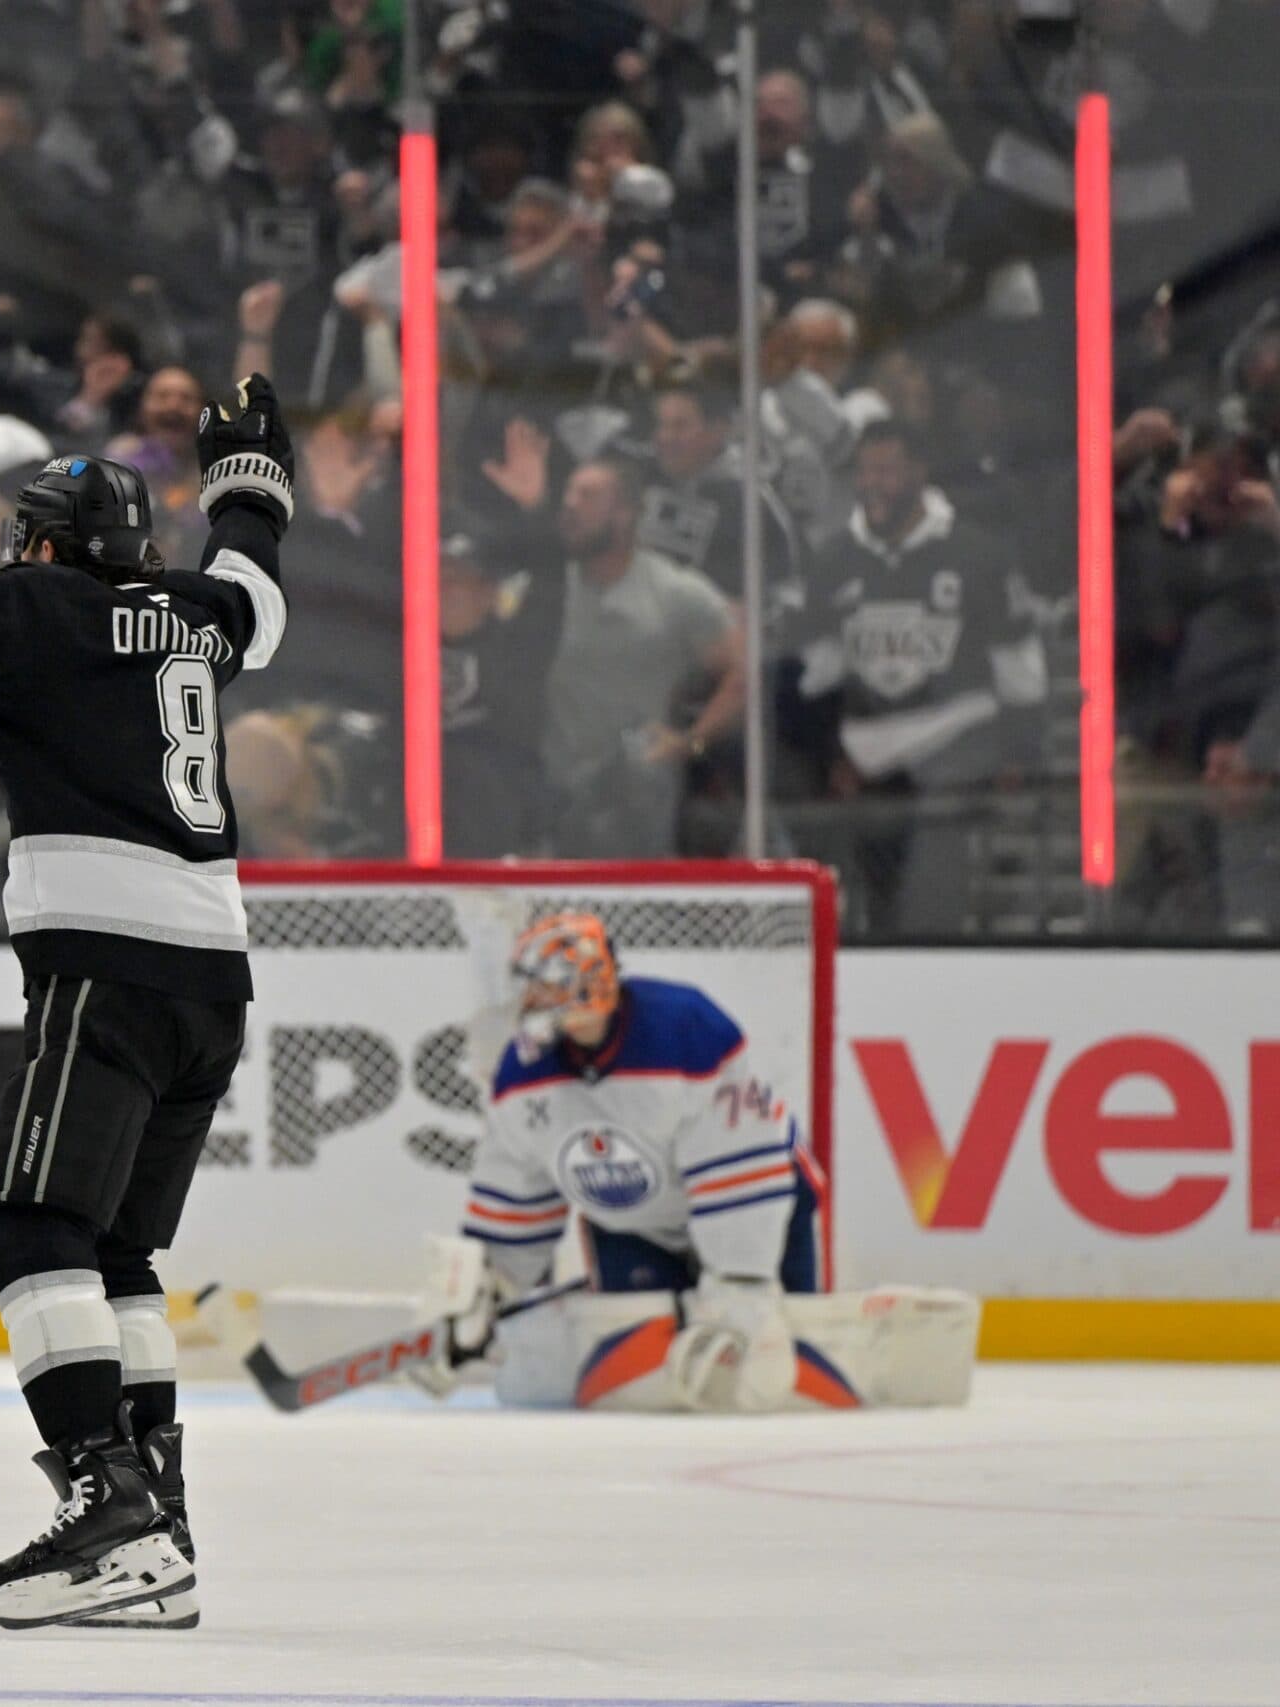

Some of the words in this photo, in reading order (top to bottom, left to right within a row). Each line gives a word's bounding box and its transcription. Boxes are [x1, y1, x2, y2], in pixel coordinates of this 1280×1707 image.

[156, 653, 225, 834] 8
[715, 1078, 773, 1128] 74
[22, 1114, 44, 1175] BAUER
[298, 1330, 433, 1408] CCM
